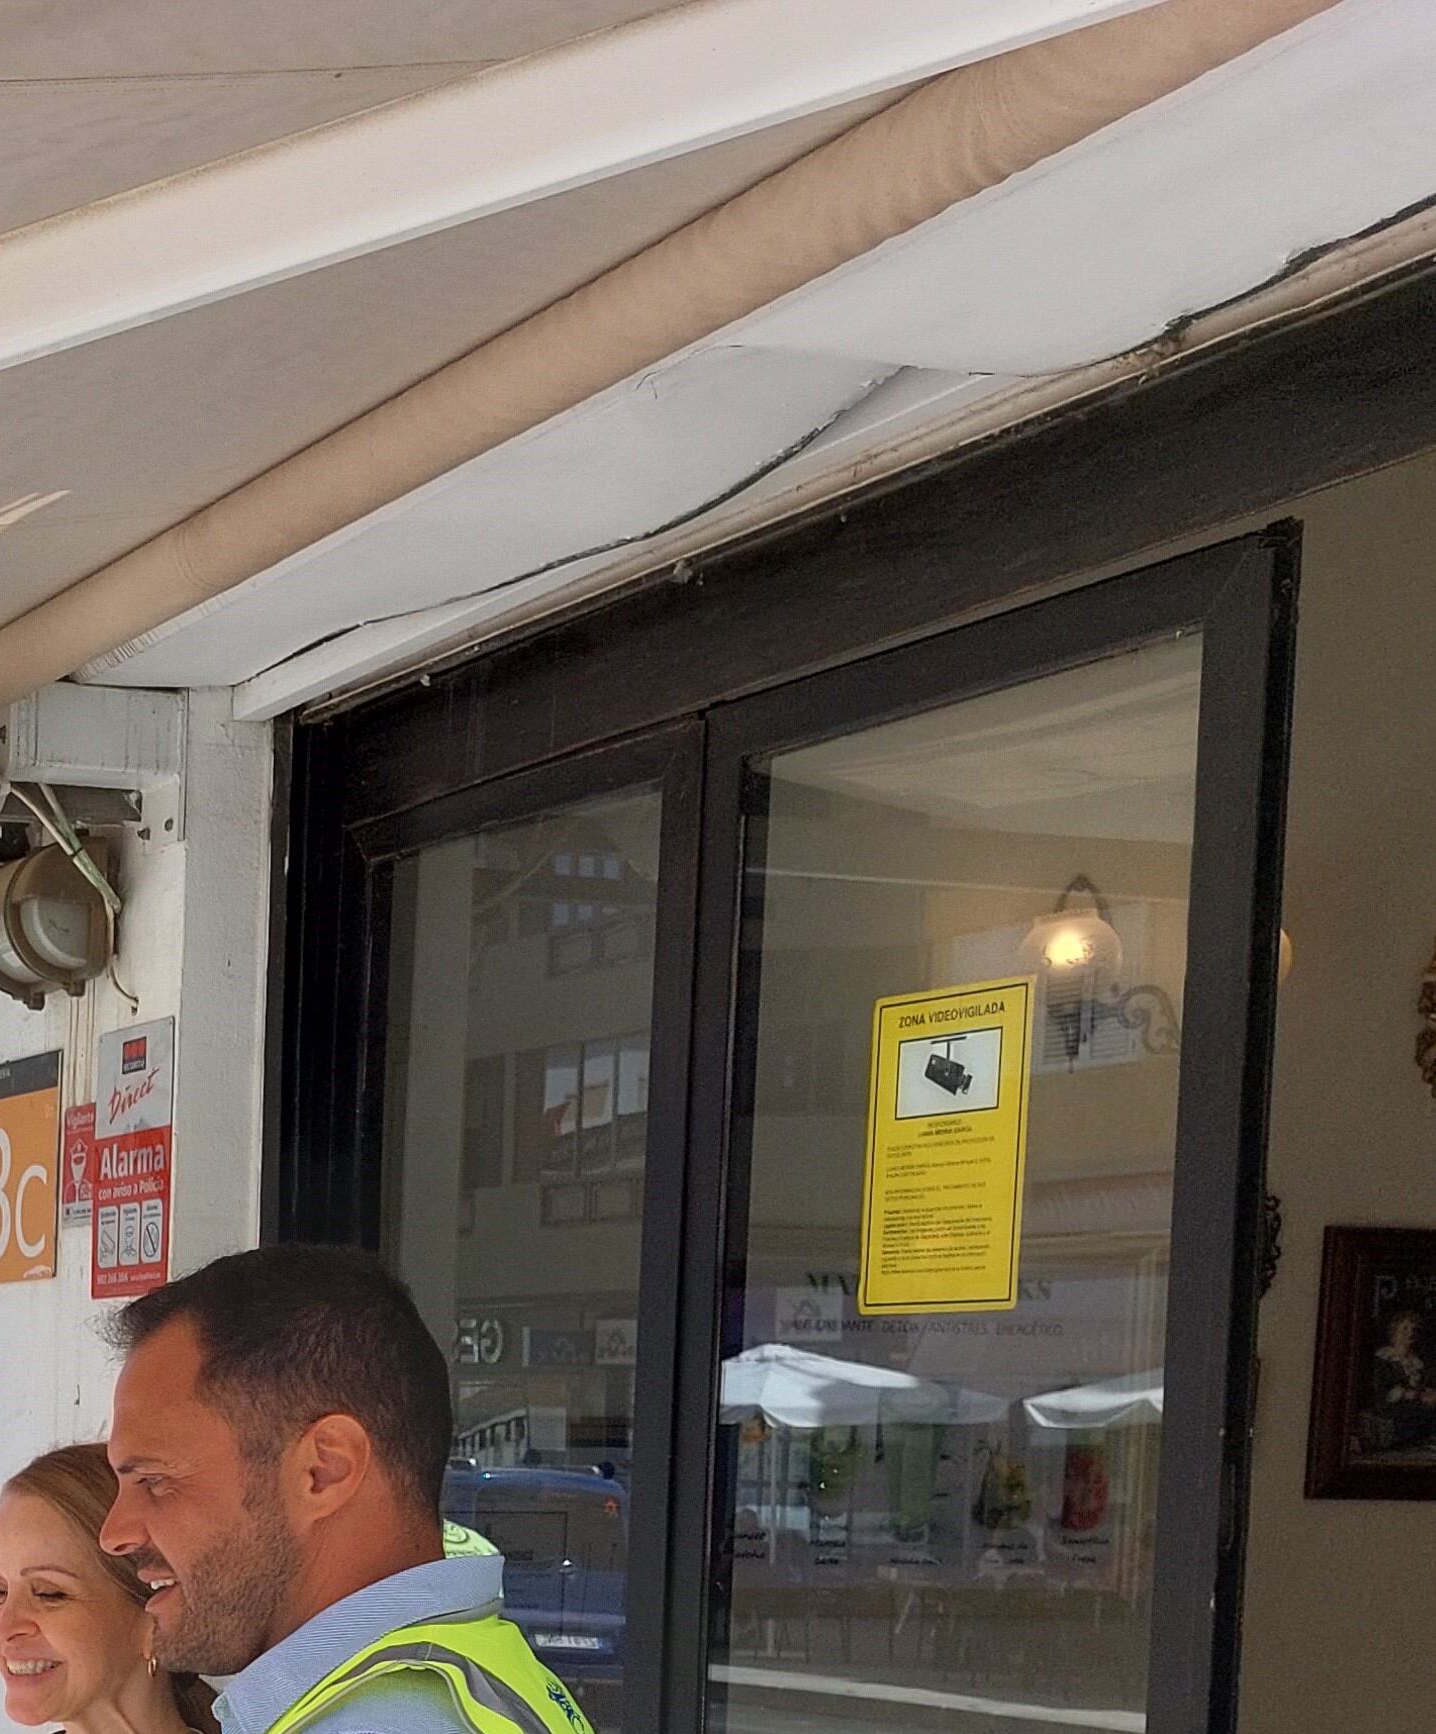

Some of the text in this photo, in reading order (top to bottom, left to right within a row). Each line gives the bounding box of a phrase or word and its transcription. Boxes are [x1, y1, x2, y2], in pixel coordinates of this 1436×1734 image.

[898, 1001, 1006, 1029] ZONA VIDEOVIGILADA
[108, 1067, 161, 1125] Direct
[100, 1143, 165, 1181] Alarma
